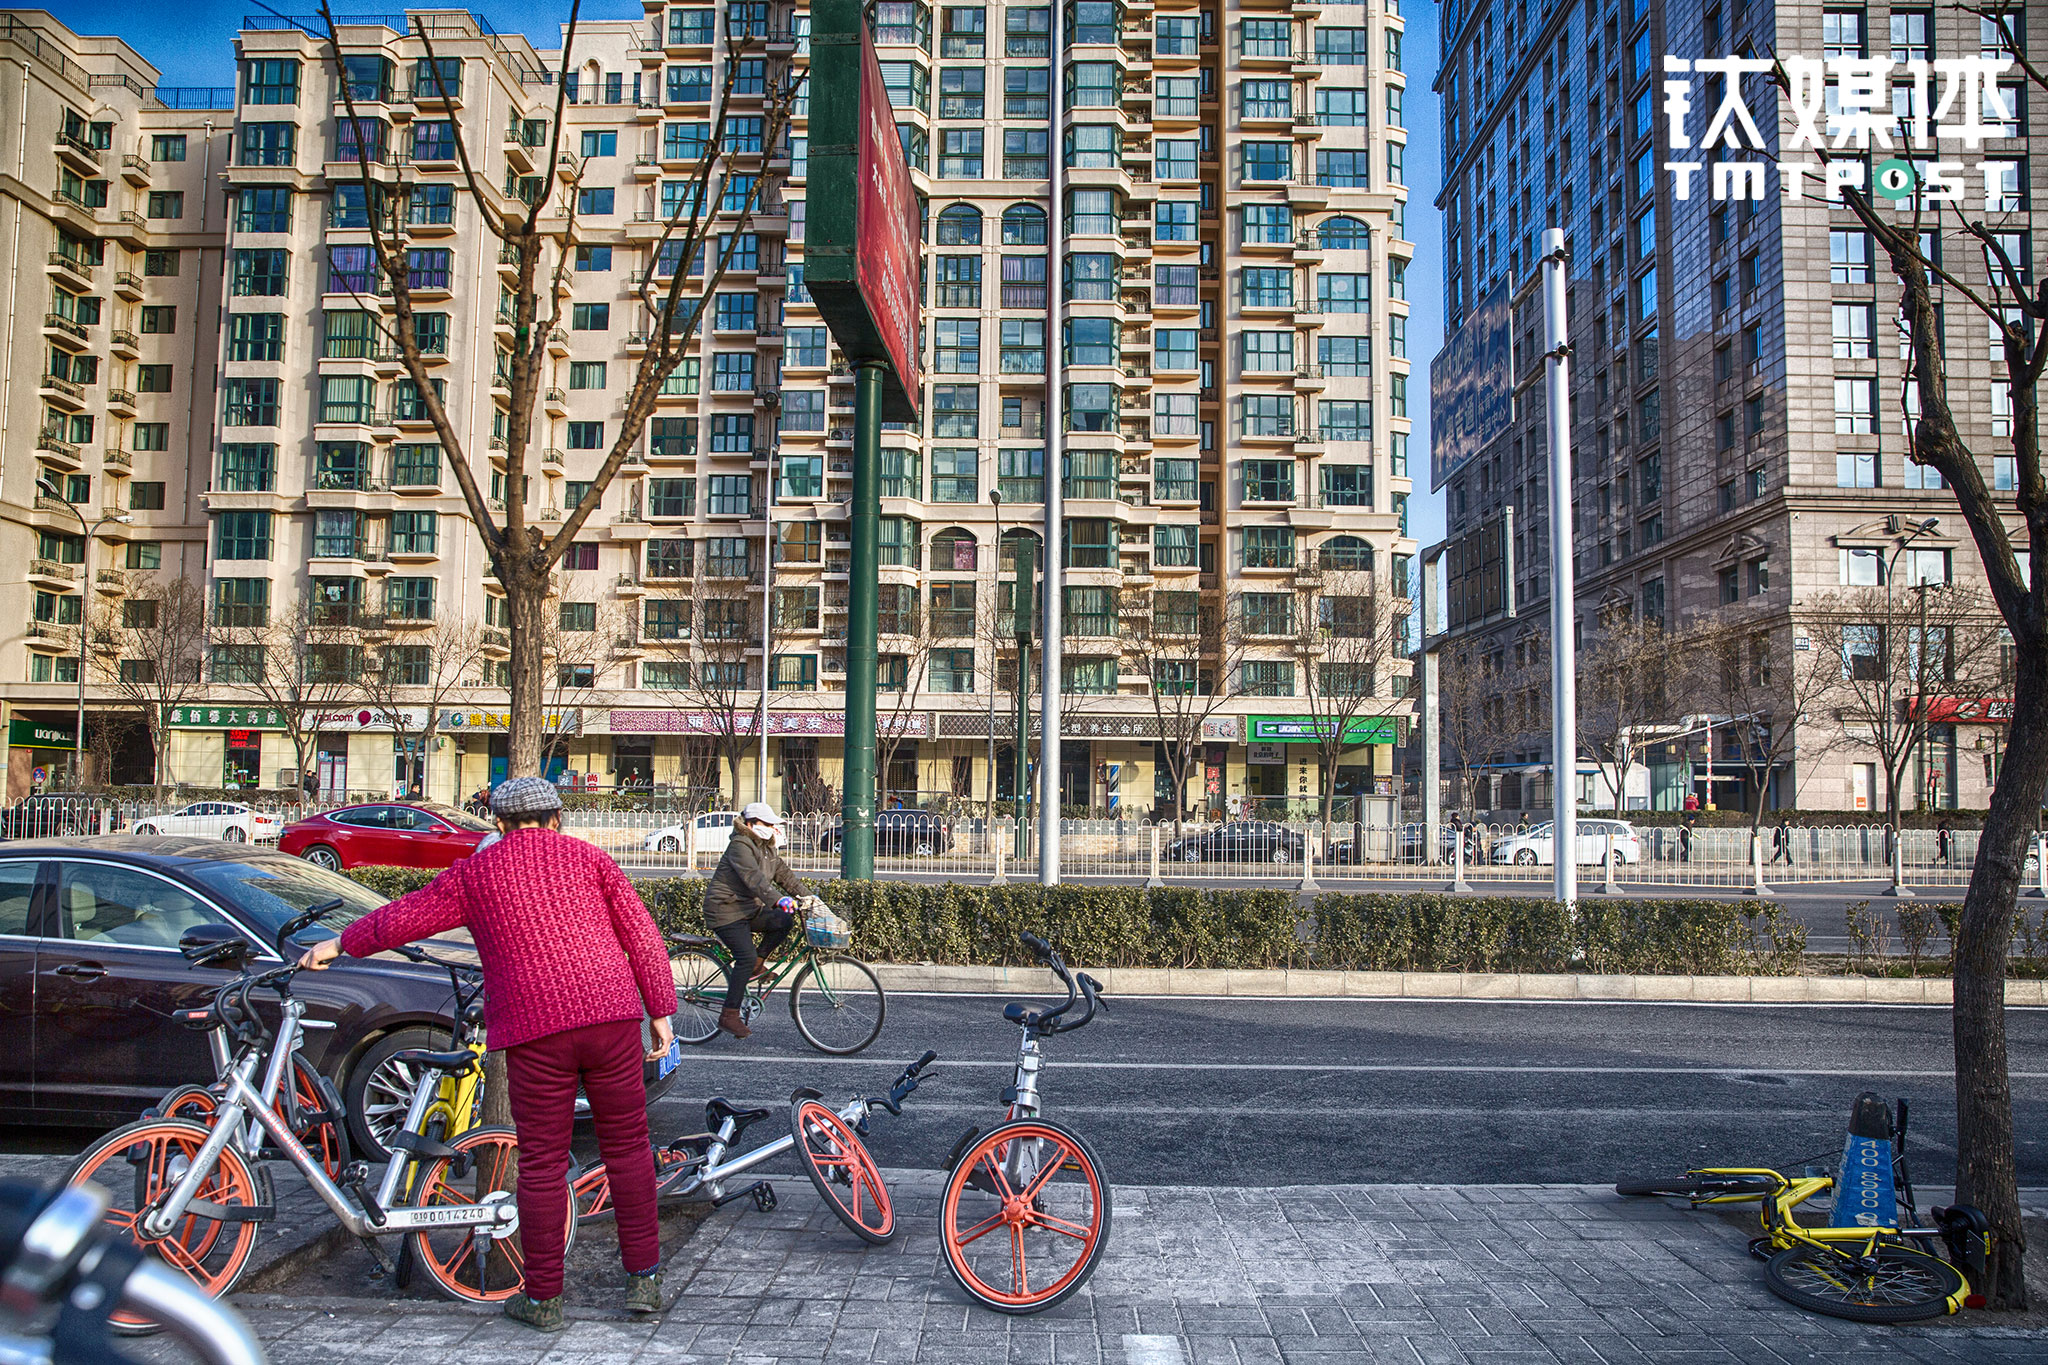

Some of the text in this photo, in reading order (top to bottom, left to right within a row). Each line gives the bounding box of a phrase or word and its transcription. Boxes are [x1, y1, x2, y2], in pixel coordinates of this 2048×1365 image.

[1433, 327, 1474, 401] 朝阳北路
[1090, 724, 1112, 734] 养生
[1120, 724, 1144, 734] 会所
[1207, 767, 1220, 794] 鲜花
[262, 1110, 309, 1160] mobike
[192, 1145, 218, 1182] mobike
[429, 1208, 484, 1222] 0014240
